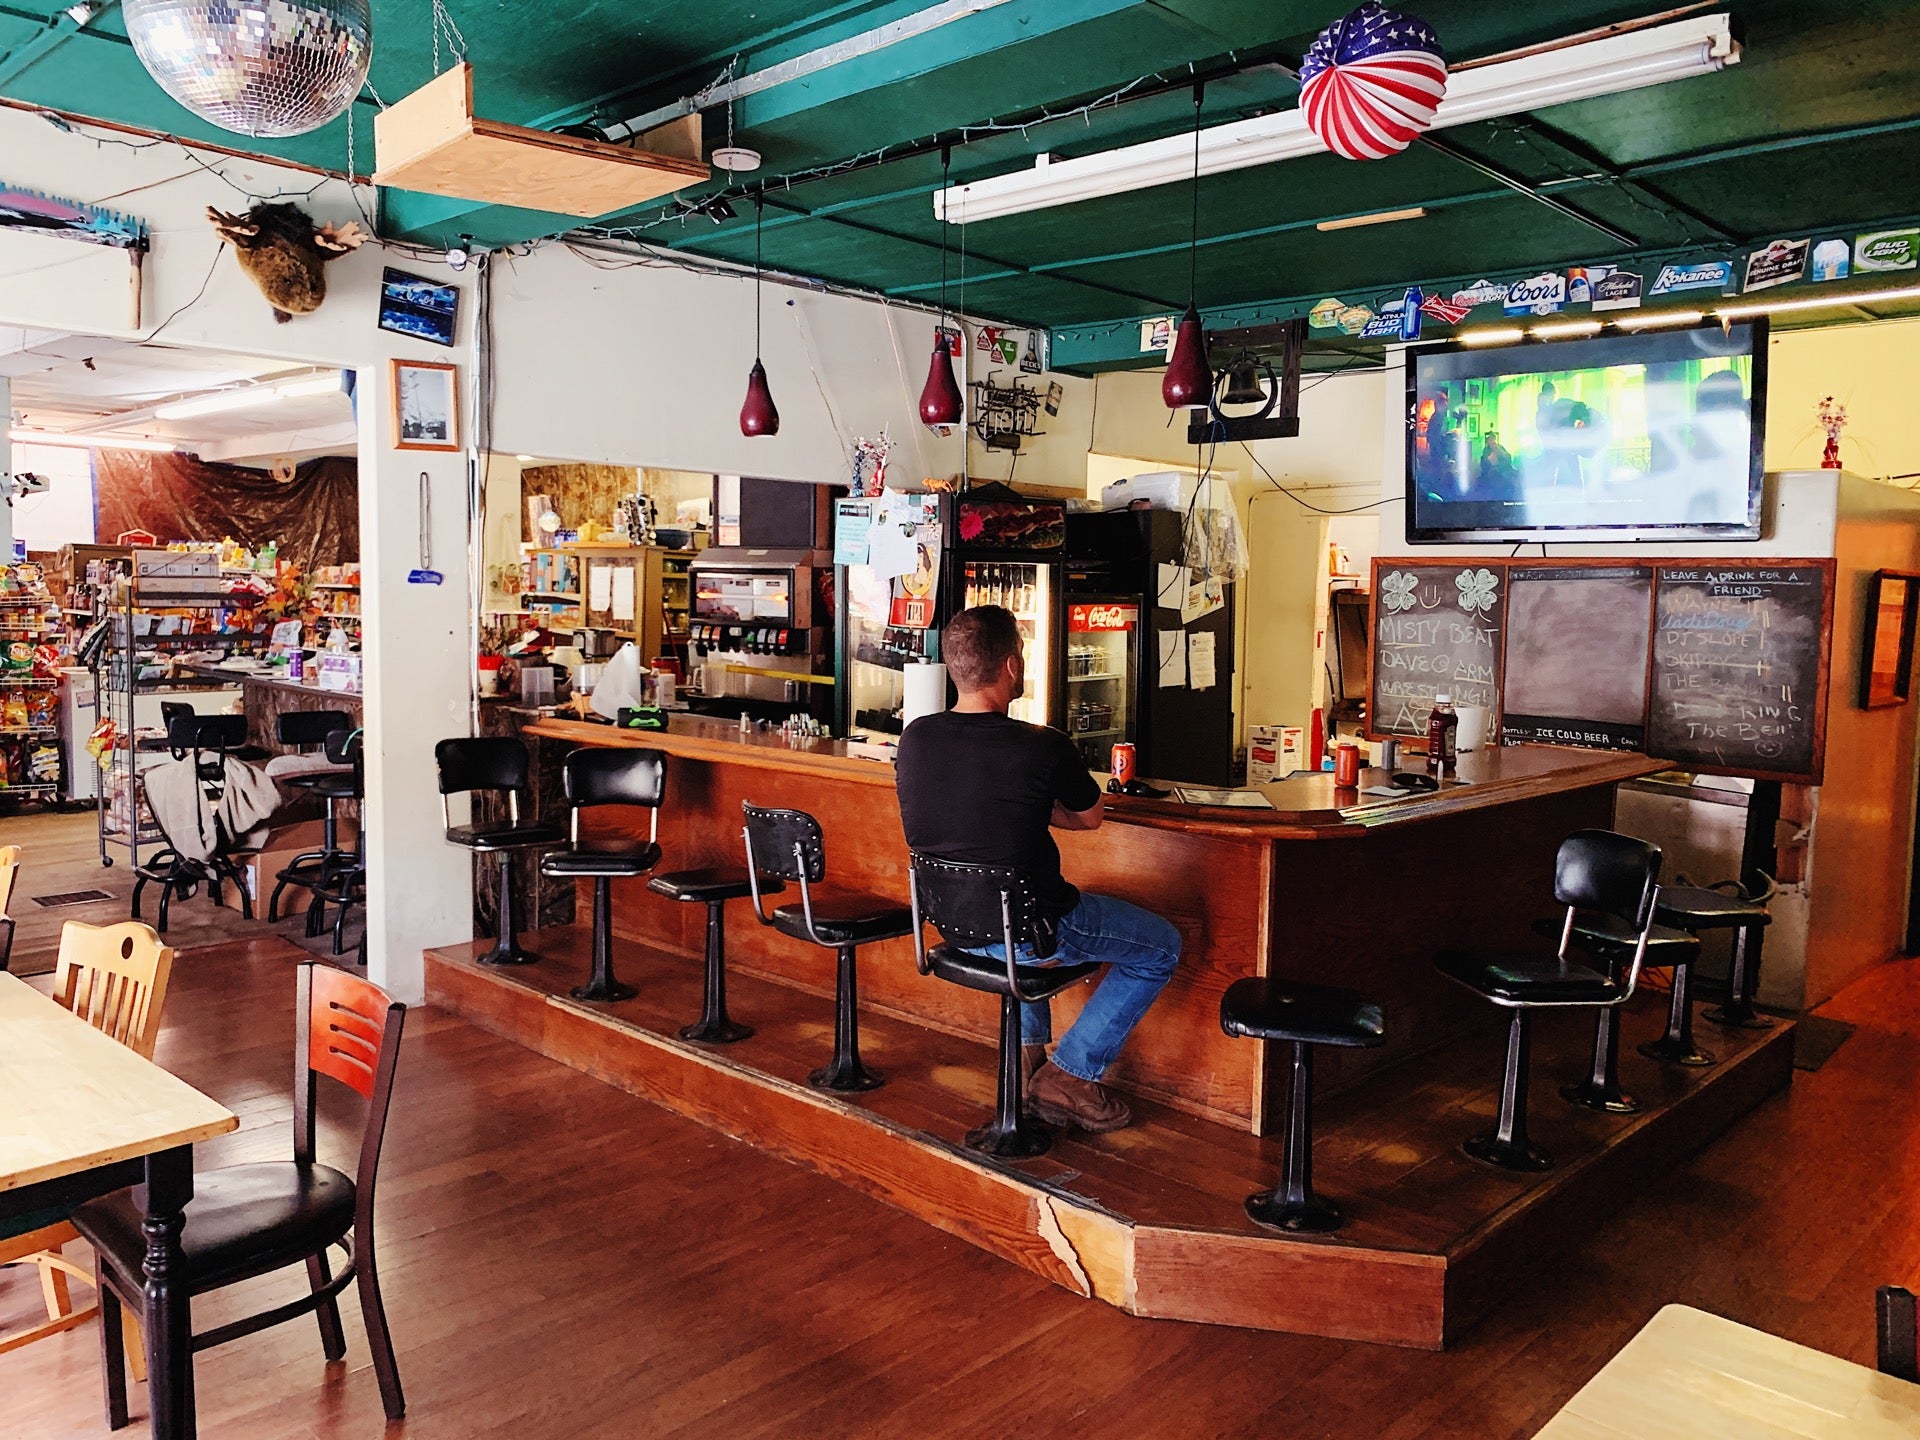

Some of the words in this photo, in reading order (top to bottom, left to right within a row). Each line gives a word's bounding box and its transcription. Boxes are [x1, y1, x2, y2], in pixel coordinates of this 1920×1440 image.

[1865, 246, 1910, 257] LIGHT
[1873, 240, 1909, 250] BUD
[1654, 266, 1724, 289] Kokanee
[1508, 280, 1560, 303] Coors
[1605, 289, 1628, 297] LAGER
[1360, 325, 1402, 337] LIGHT
[1368, 319, 1400, 329] BUD
[1662, 570, 1699, 580] LEAVE
[1720, 571, 1755, 581] DRINK
[1759, 571, 1780, 580] FOR
[1788, 571, 1798, 581] A
[1380, 615, 1441, 644] MISTY
[1449, 622, 1499, 648] BEAT
[1666, 631, 1692, 646] DJ
[1380, 649, 1430, 672] DAVE
[1453, 659, 1495, 686] ARM
[1665, 672, 1702, 688] THE
[1741, 706, 1801, 722] RING
[1536, 727, 1554, 738] ICE
[1557, 729, 1582, 740] COLD
[1584, 732, 1610, 743] BEER
